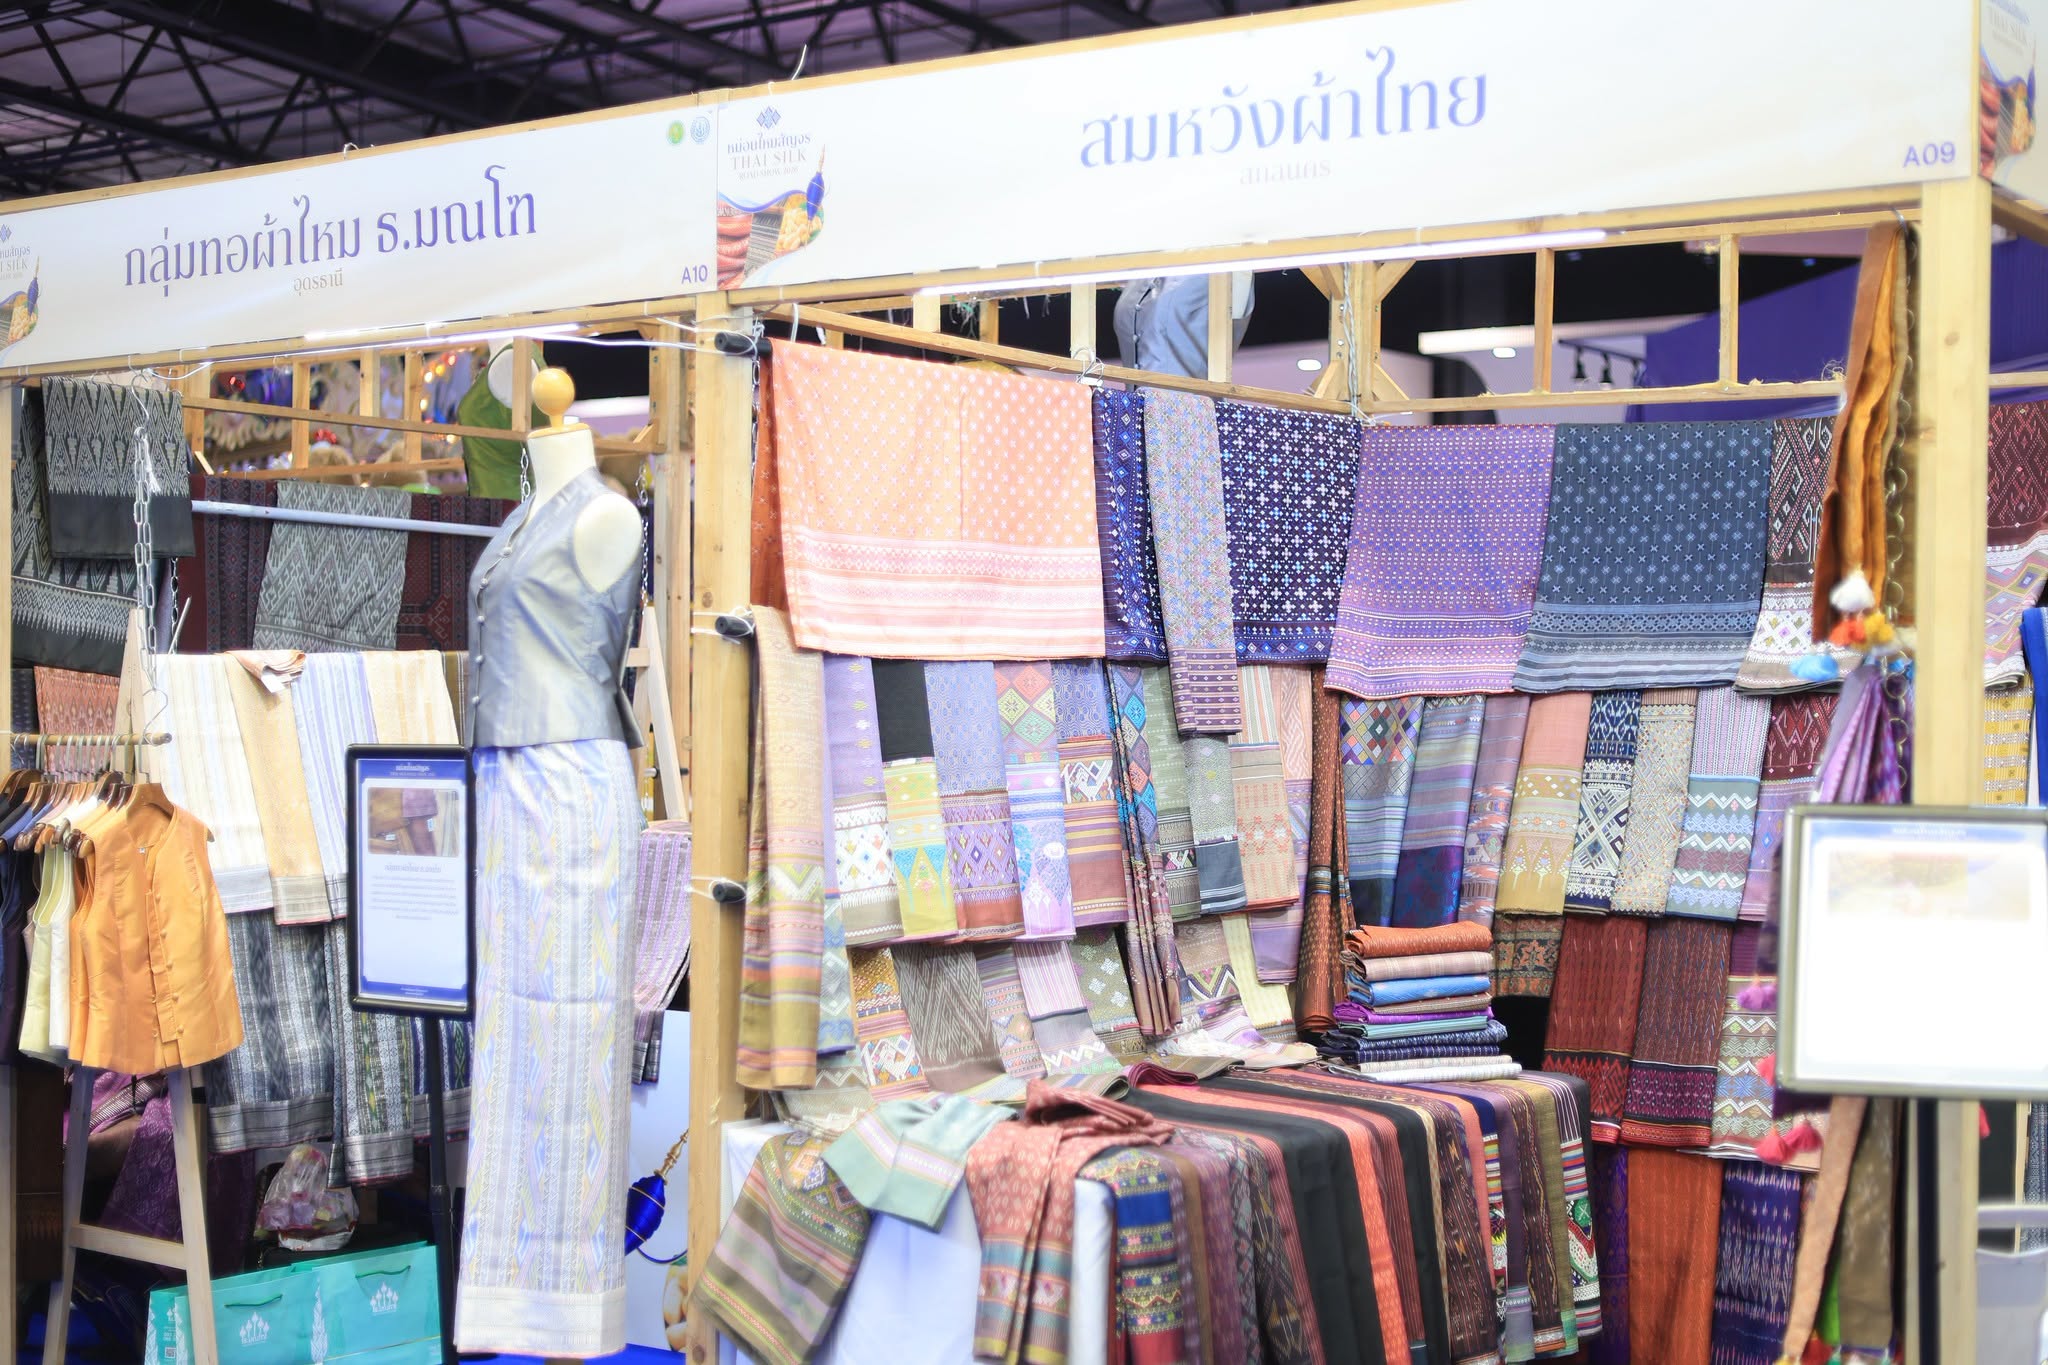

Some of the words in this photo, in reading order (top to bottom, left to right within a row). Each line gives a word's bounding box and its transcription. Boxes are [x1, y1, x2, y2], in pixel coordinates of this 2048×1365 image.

[1080, 45, 1487, 169] สมหวังผ้าไทย
[1903, 141, 1957, 168] A09
[125, 194, 361, 297] กลุ่มทอผ้าไหม
[294, 268, 343, 297] อุดรธานี
[681, 264, 709, 285] A10
